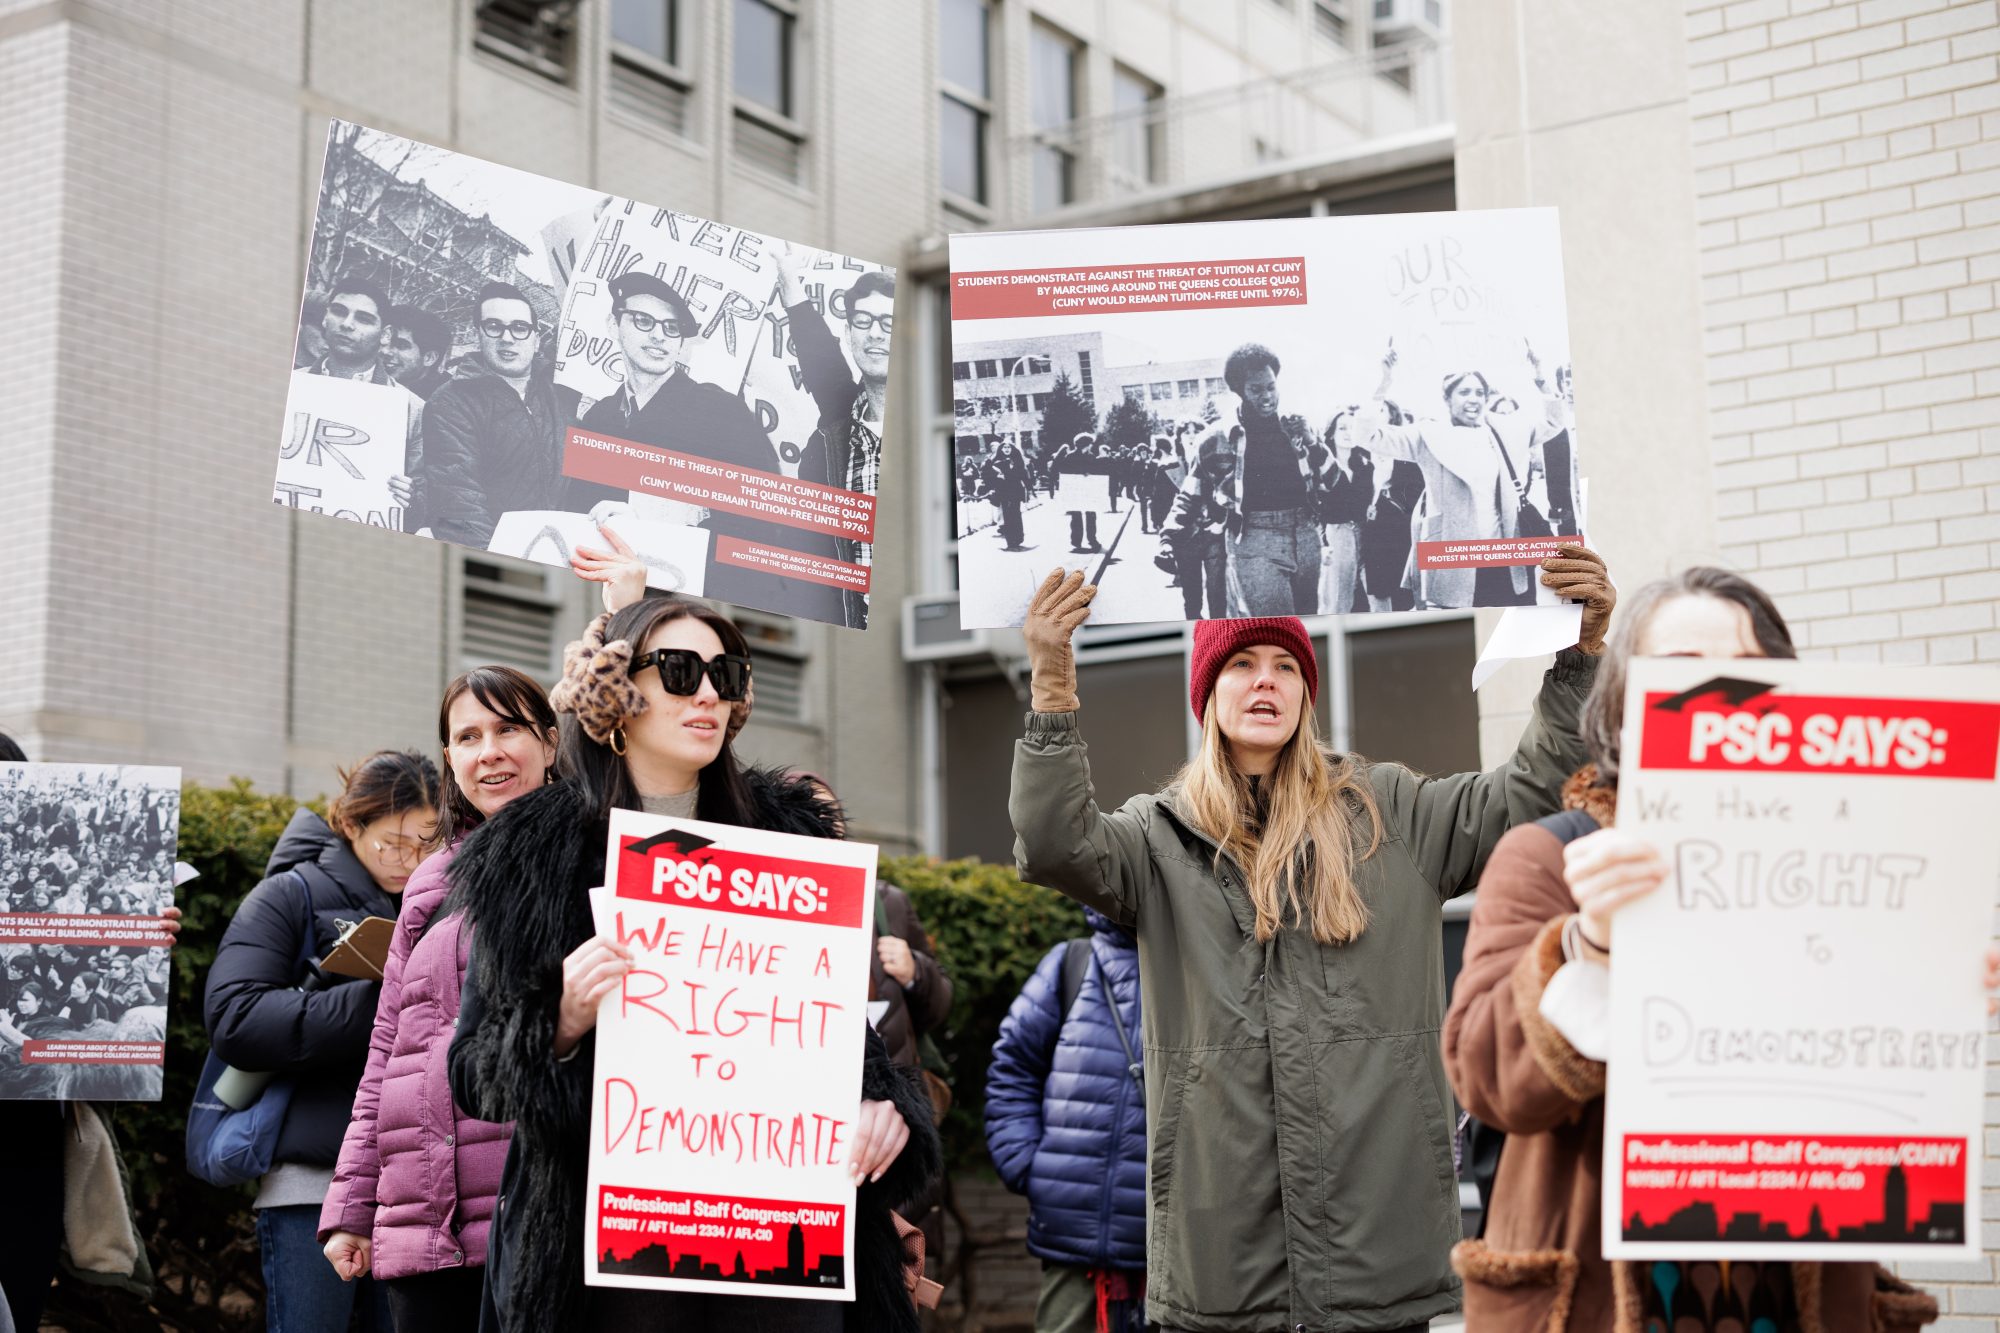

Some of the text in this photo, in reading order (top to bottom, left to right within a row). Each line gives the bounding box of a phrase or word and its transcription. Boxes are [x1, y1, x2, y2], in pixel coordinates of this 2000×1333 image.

[957, 262, 1302, 287] STUDENTS DEMONSTRATE AGAINST THE THREAT OF TUITION AT CUNY
[1037, 275, 1300, 296] BY MARCHING AROUND THE QUEENS COLLEGE QUAD
[1053, 288, 1303, 309] (CUNY WOULD REMAIN TUITION-FREE UNTIL 1976).
[572, 434, 872, 510] STUDENTS PROTEST THE THREAT OF TUITION AT CUNY IN 1965 ON
[640, 475, 870, 534] (CUNY WOULD REMAIN TUITION-FREE UNTIL 1976).
[740, 486, 869, 522] THE QUEENS COLLEGE QUAD
[748, 547, 867, 578] LEARN MORE ABOUT QC ACTIVISM AND
[1428, 554, 1459, 562] PROTEST
[1483, 552, 1512, 561] QUEENS
[1513, 551, 1544, 559] COLLEGE
[1445, 545, 1468, 553] LEARN
[1470, 544, 1490, 552] MORE
[1492, 543, 1516, 551] ABOUT
[1530, 541, 1558, 549] ACTIVIS
[732, 552, 759, 562] PROTEST
[769, 559, 780, 567] THE
[781, 561, 807, 573] QUEENS
[807, 567, 834, 579] COLLEGE
[835, 572, 866, 586] ARCHIVES
[1688, 711, 1948, 769] PSC SAYS:
[1834, 797, 1851, 822] A
[652, 856, 828, 915] PSC SAYS:
[1675, 838, 1928, 911] RIGHT
[17, 917, 47, 926] RALLY
[48, 918, 68, 927] AND
[69, 919, 135, 929] DEMONSTRATE
[136, 920, 160, 928] BEHIN
[18, 928, 57, 938] SCIENCE
[58, 930, 102, 940] BUILDING,
[104, 931, 143, 939] AROUND
[616, 911, 831, 978] WE HAVE A
[622, 970, 844, 1049] RIGHT
[1642, 995, 1984, 1070] DEMONSTRATE
[691, 1053, 736, 1081] TO
[605, 1078, 848, 1168] DEMONSTRATE
[1627, 1139, 1961, 1169] Professional Staff Congress/CUNY
[603, 1192, 840, 1227] Professional Staff Congress/CUNY
[602, 1216, 772, 1242] NYSUT / AFT Local 2334 / AFL-CIO
